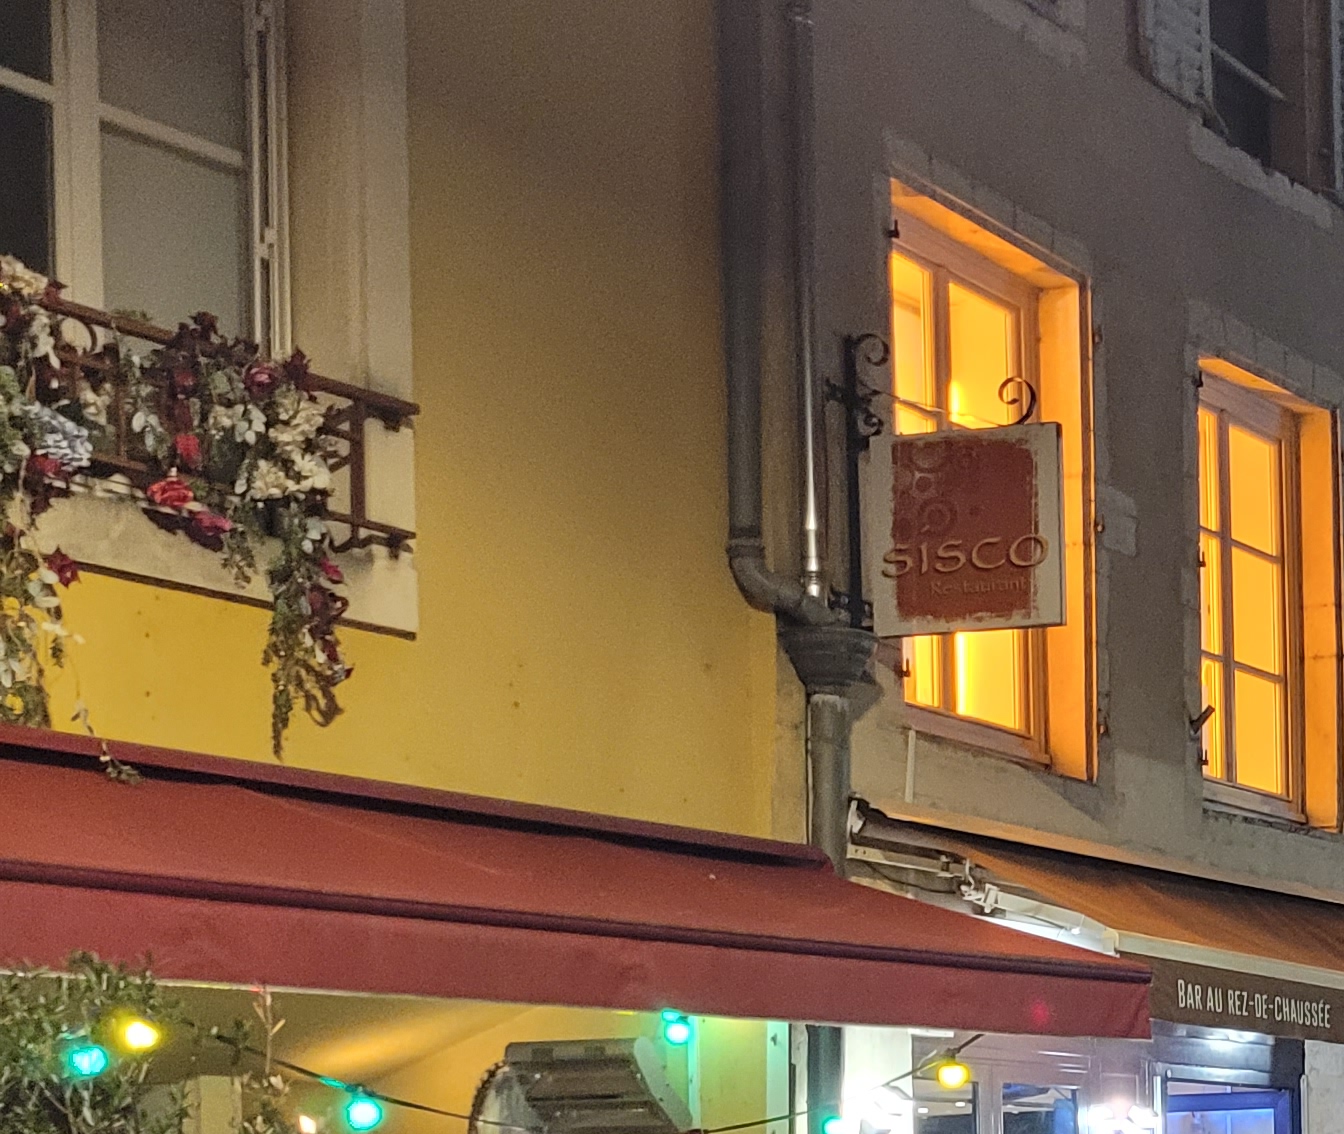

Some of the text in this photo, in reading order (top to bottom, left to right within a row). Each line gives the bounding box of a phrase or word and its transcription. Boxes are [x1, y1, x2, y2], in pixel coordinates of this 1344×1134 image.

[882, 534, 1049, 578] SISCO
[930, 577, 1026, 596] Restaurant
[1177, 978, 1332, 1029] BAR AU REZ-DE-CHAUSSÉE
